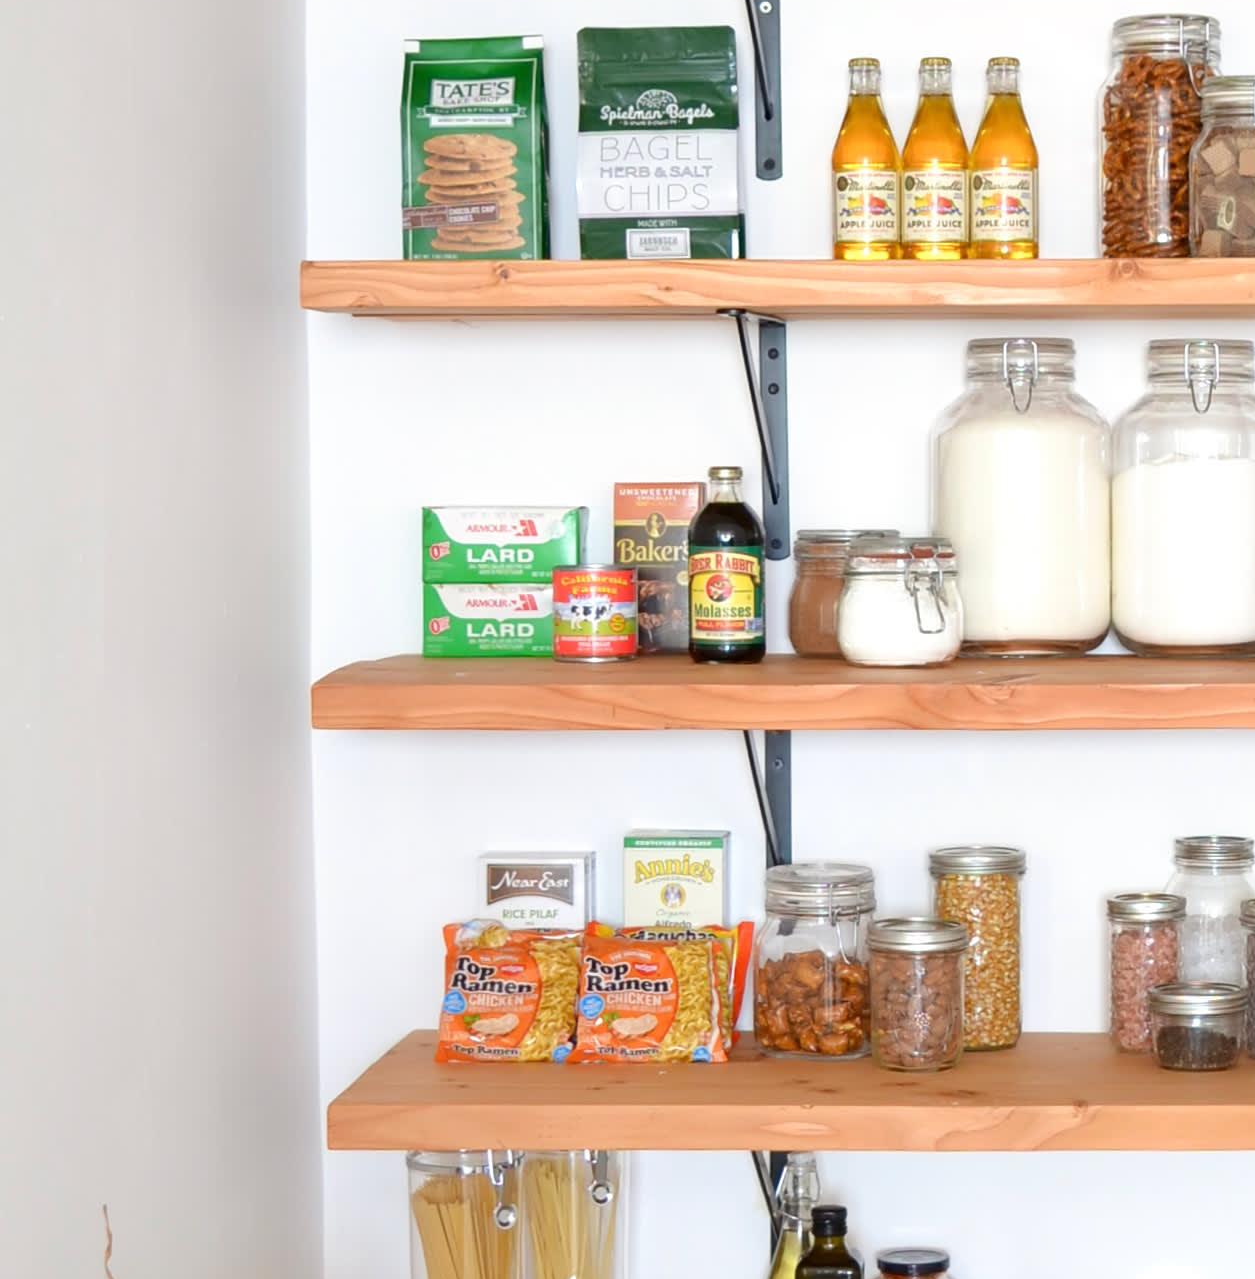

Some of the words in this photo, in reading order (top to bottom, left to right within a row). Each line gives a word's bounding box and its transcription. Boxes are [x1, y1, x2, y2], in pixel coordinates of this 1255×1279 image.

[436, 81, 510, 100] TATE'S
[600, 104, 663, 126] Spielman
[665, 103, 716, 125] Bagels
[600, 135, 714, 162] BAGEL
[599, 165, 651, 179] HERB
[653, 165, 668, 178] &
[669, 165, 713, 178] SALT
[603, 182, 711, 212] CHIPS
[449, 207, 480, 215] CHOCOLATE
[840, 220, 865, 229] APPLE
[619, 488, 695, 497] UNSWEETENED
[465, 523, 509, 533] ARMOUR
[466, 548, 535, 563] LARD
[616, 538, 690, 564] Baker's
[715, 553, 756, 573] RABBIT
[560, 574, 629, 587] California
[465, 598, 508, 608] ARMOUR
[693, 602, 752, 618] Molasses
[466, 623, 535, 638] LARD
[634, 854, 716, 884] Annie's
[490, 871, 539, 891] Near
[537, 871, 570, 891] East
[502, 909, 527, 920] RICE
[529, 909, 560, 920] PILAF
[457, 957, 495, 981] Top
[585, 957, 630, 981] Top
[451, 973, 533, 994] Ramen
[585, 975, 671, 993] Ramen
[468, 994, 524, 1007] CHICKEN
[606, 994, 662, 1007] CHICKEN
